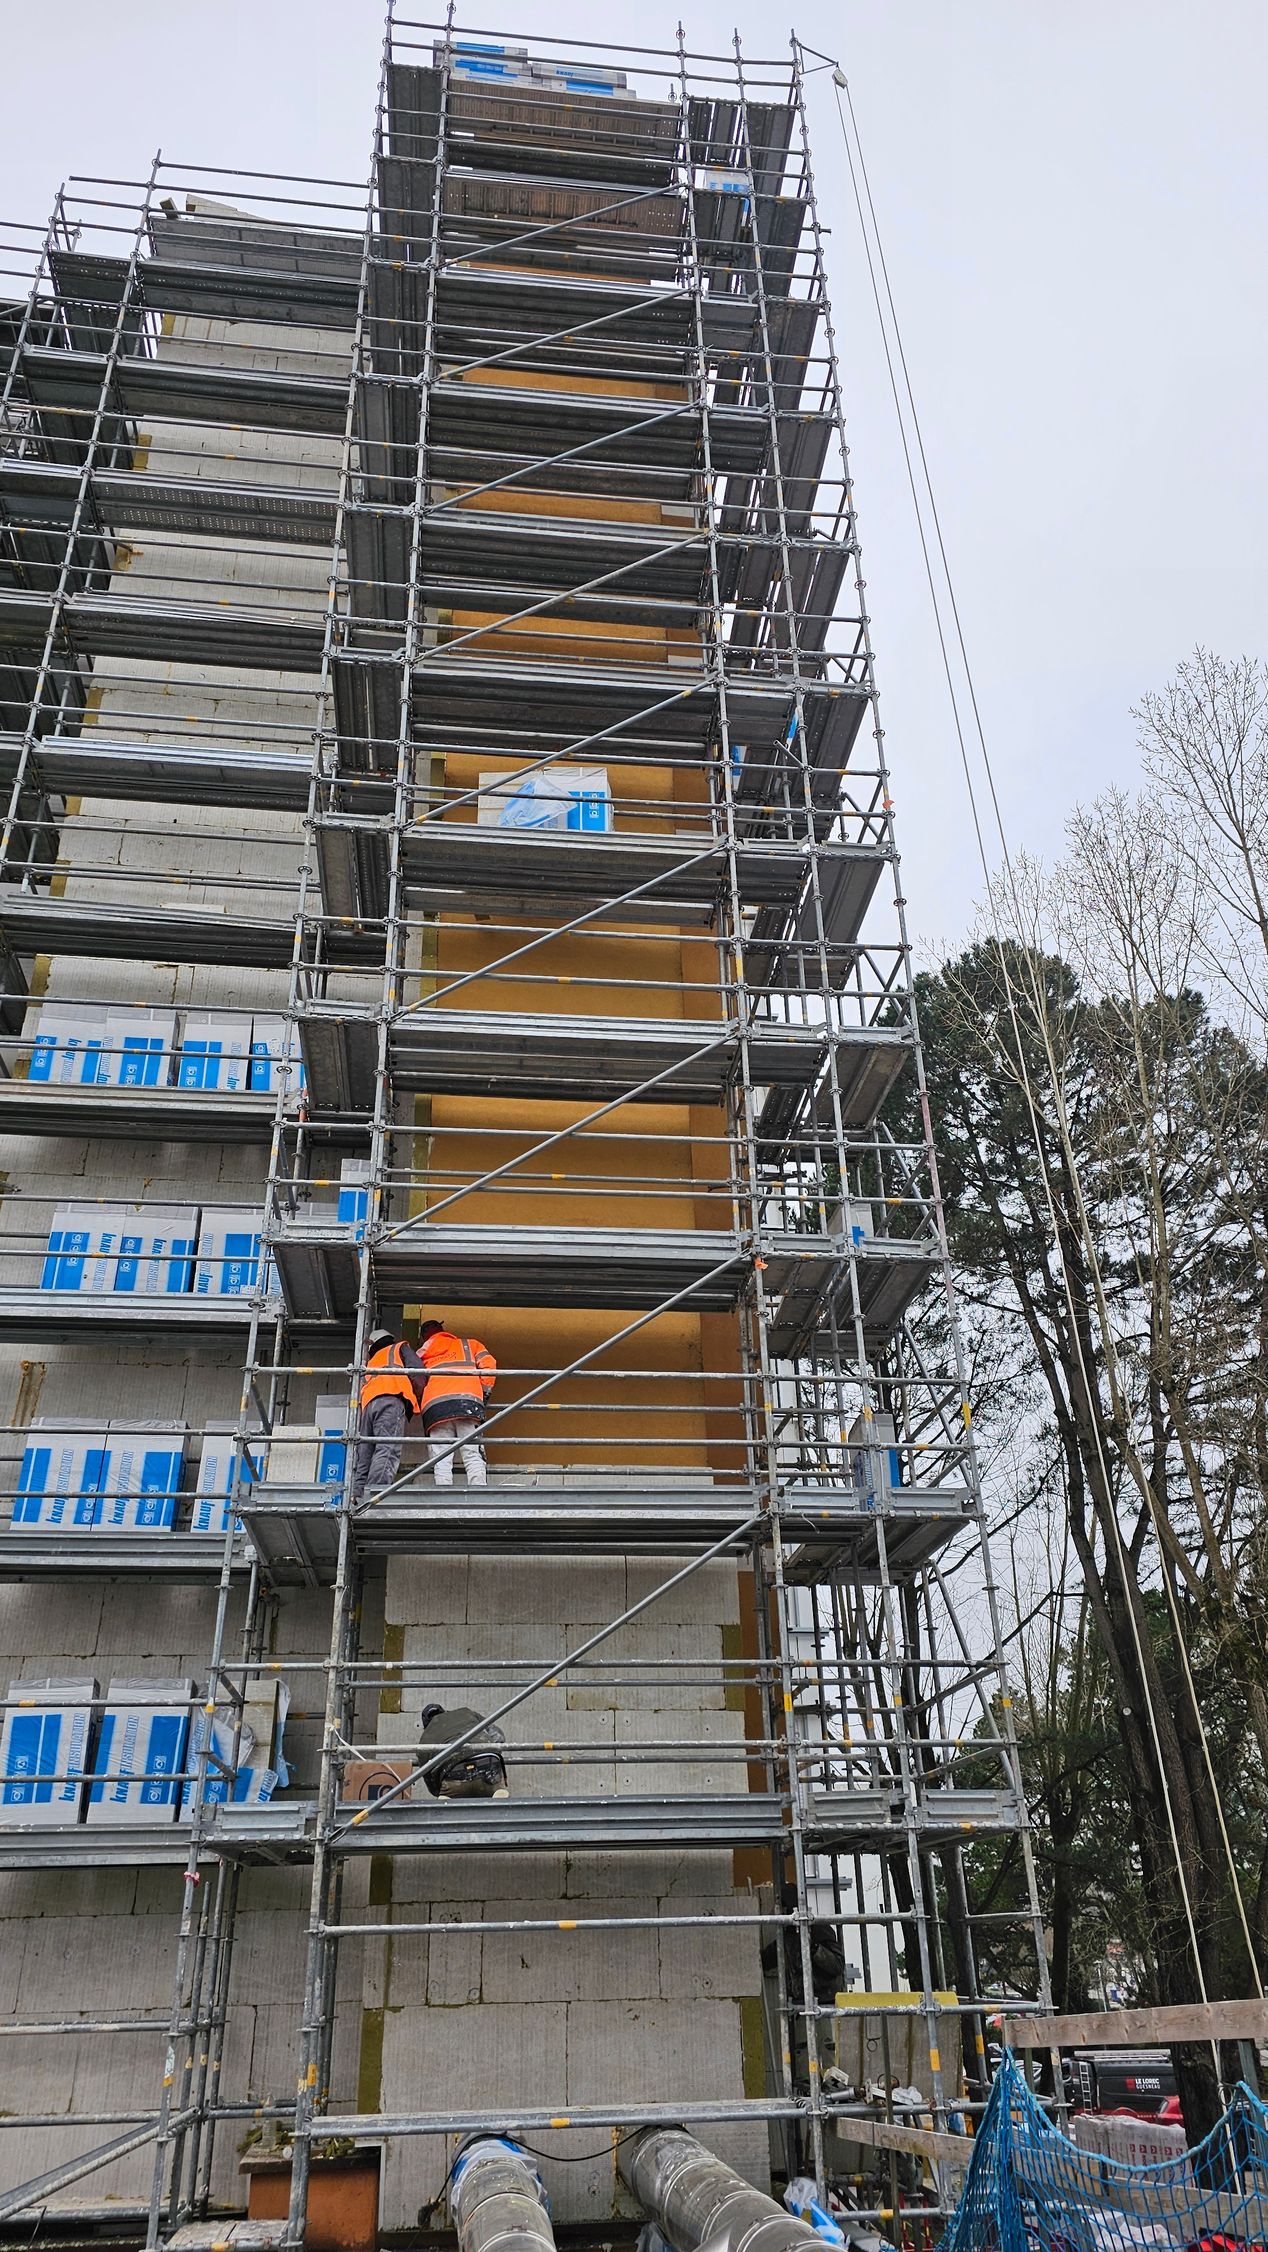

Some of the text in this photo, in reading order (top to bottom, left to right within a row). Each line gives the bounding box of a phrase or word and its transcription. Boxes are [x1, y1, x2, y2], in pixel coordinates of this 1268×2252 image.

[99, 1232, 117, 1254] KNAU
[193, 1500, 215, 1530] KNAUF
[67, 1712, 85, 1769] INSULATION
[120, 1714, 140, 1770] INSULATION
